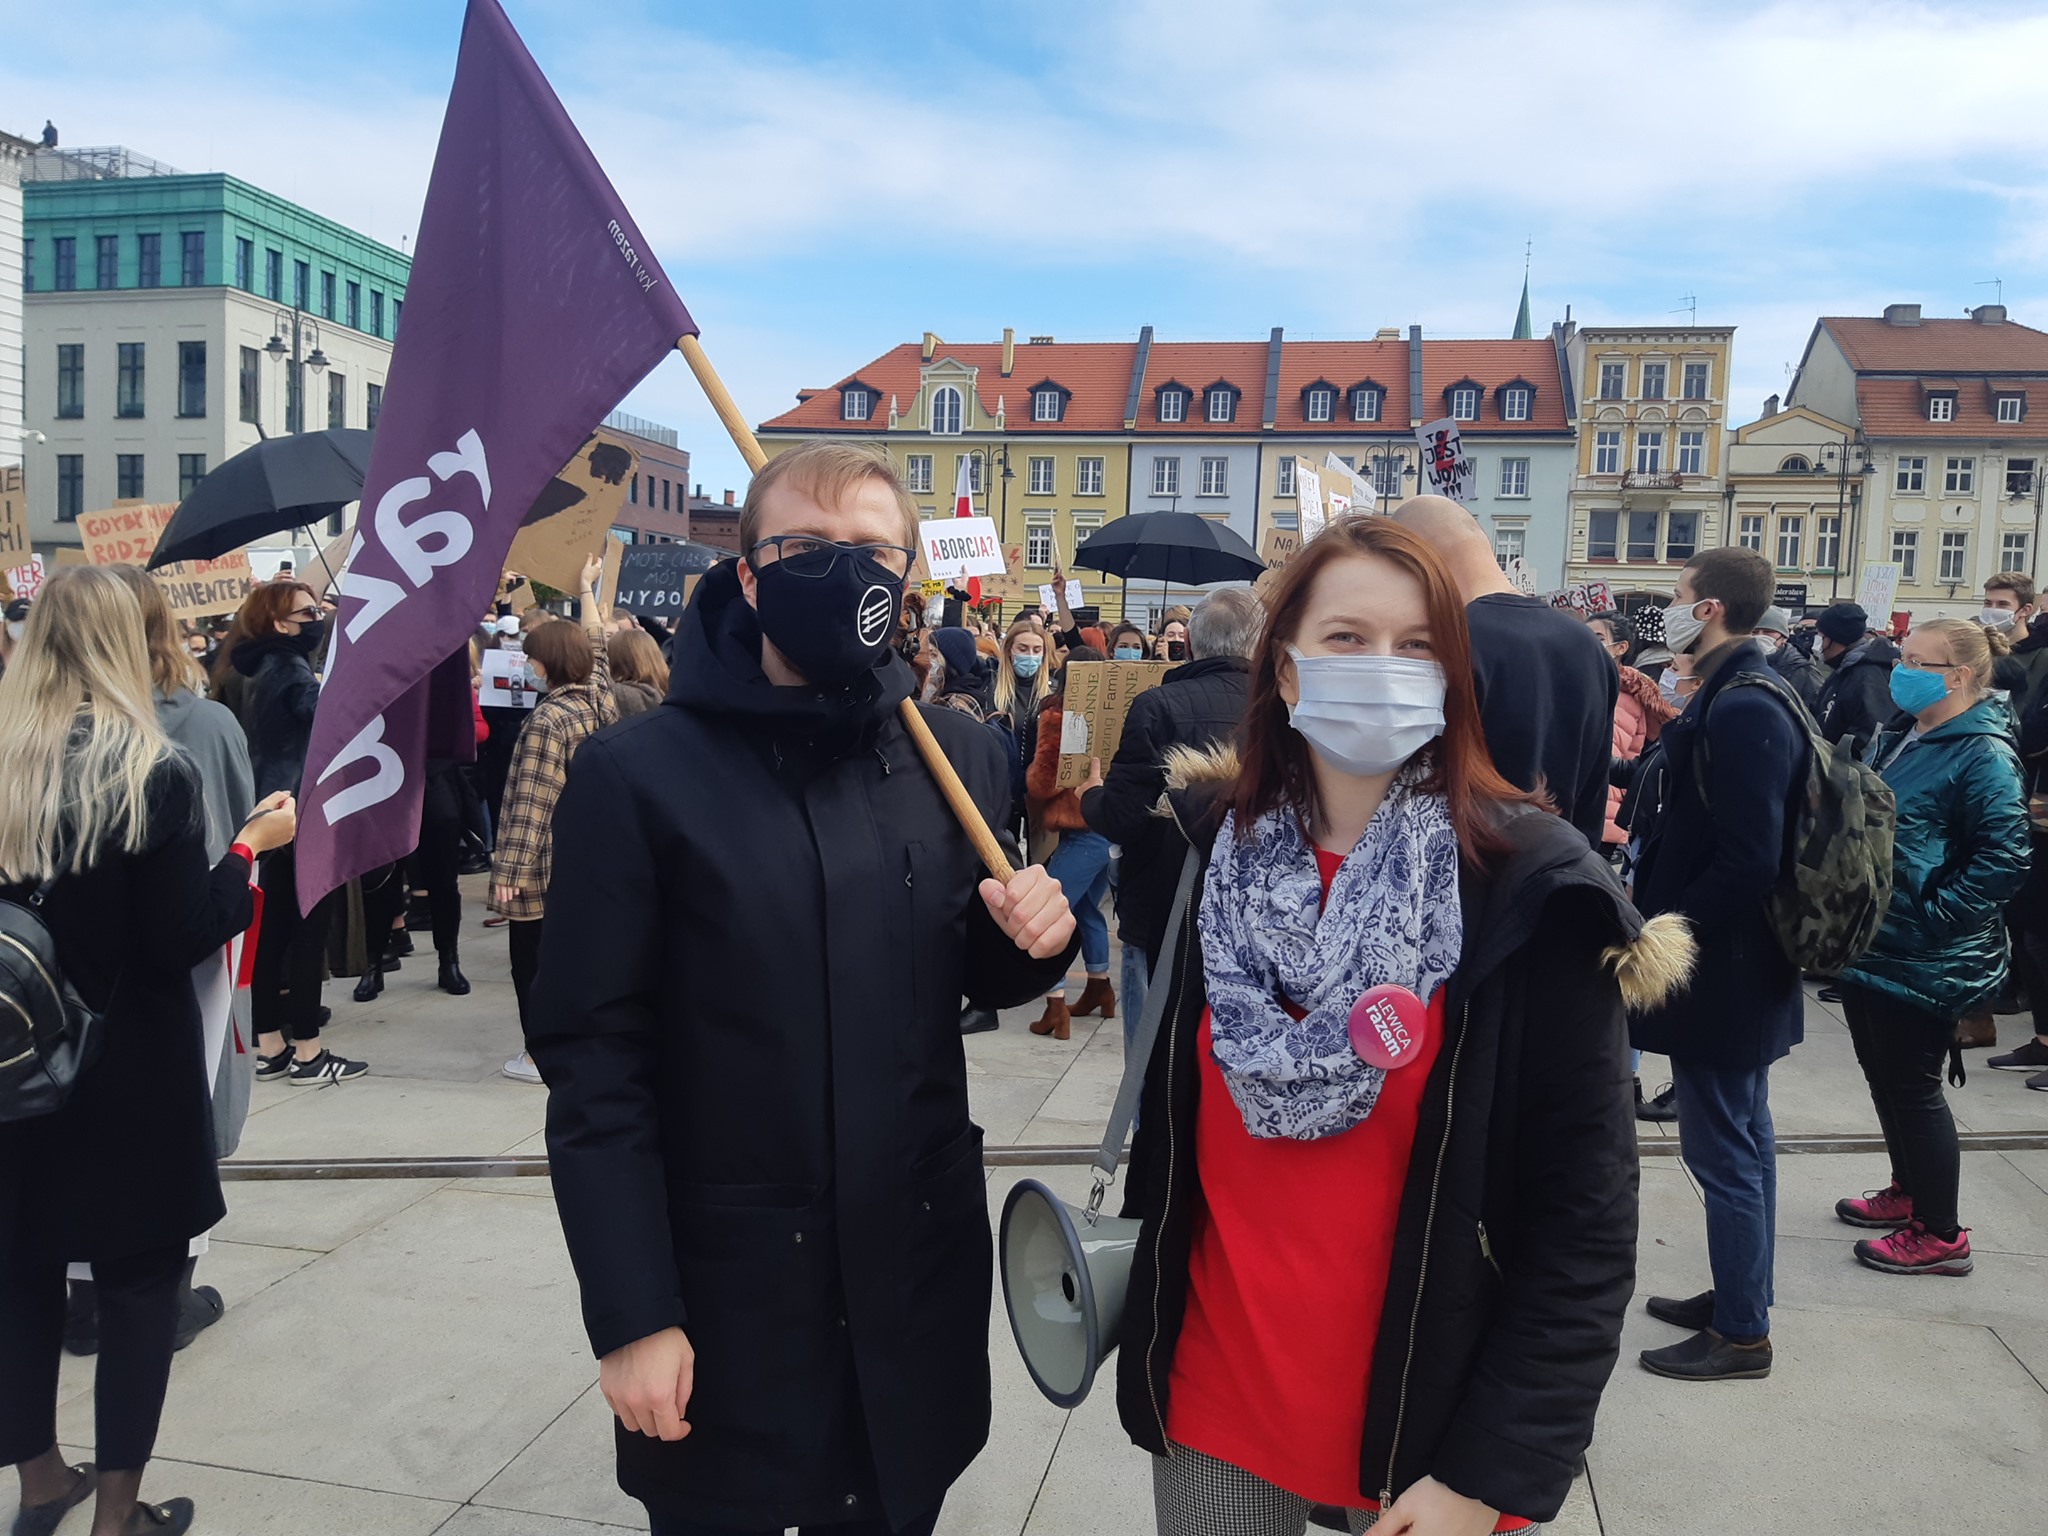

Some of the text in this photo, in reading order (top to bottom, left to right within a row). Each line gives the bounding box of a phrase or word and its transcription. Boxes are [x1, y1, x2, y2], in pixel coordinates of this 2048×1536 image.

[1425, 430, 1446, 443] TO
[1424, 436, 1462, 465] JEST
[1428, 460, 1472, 486] WOJNA
[931, 536, 995, 561] ABORCJA?
[1274, 537, 1292, 551] NA
[625, 553, 663, 568] MOJE
[644, 569, 678, 586] MÓJ
[162, 577, 251, 610] RAMENTEM
[618, 586, 686, 606] WYBÓ
[1103, 661, 1122, 710] Family
[1060, 753, 1073, 780] Saf
[1068, 669, 1080, 712] eficial
[1365, 1004, 1401, 1058] razem
[1377, 997, 1412, 1050] LEWICA
